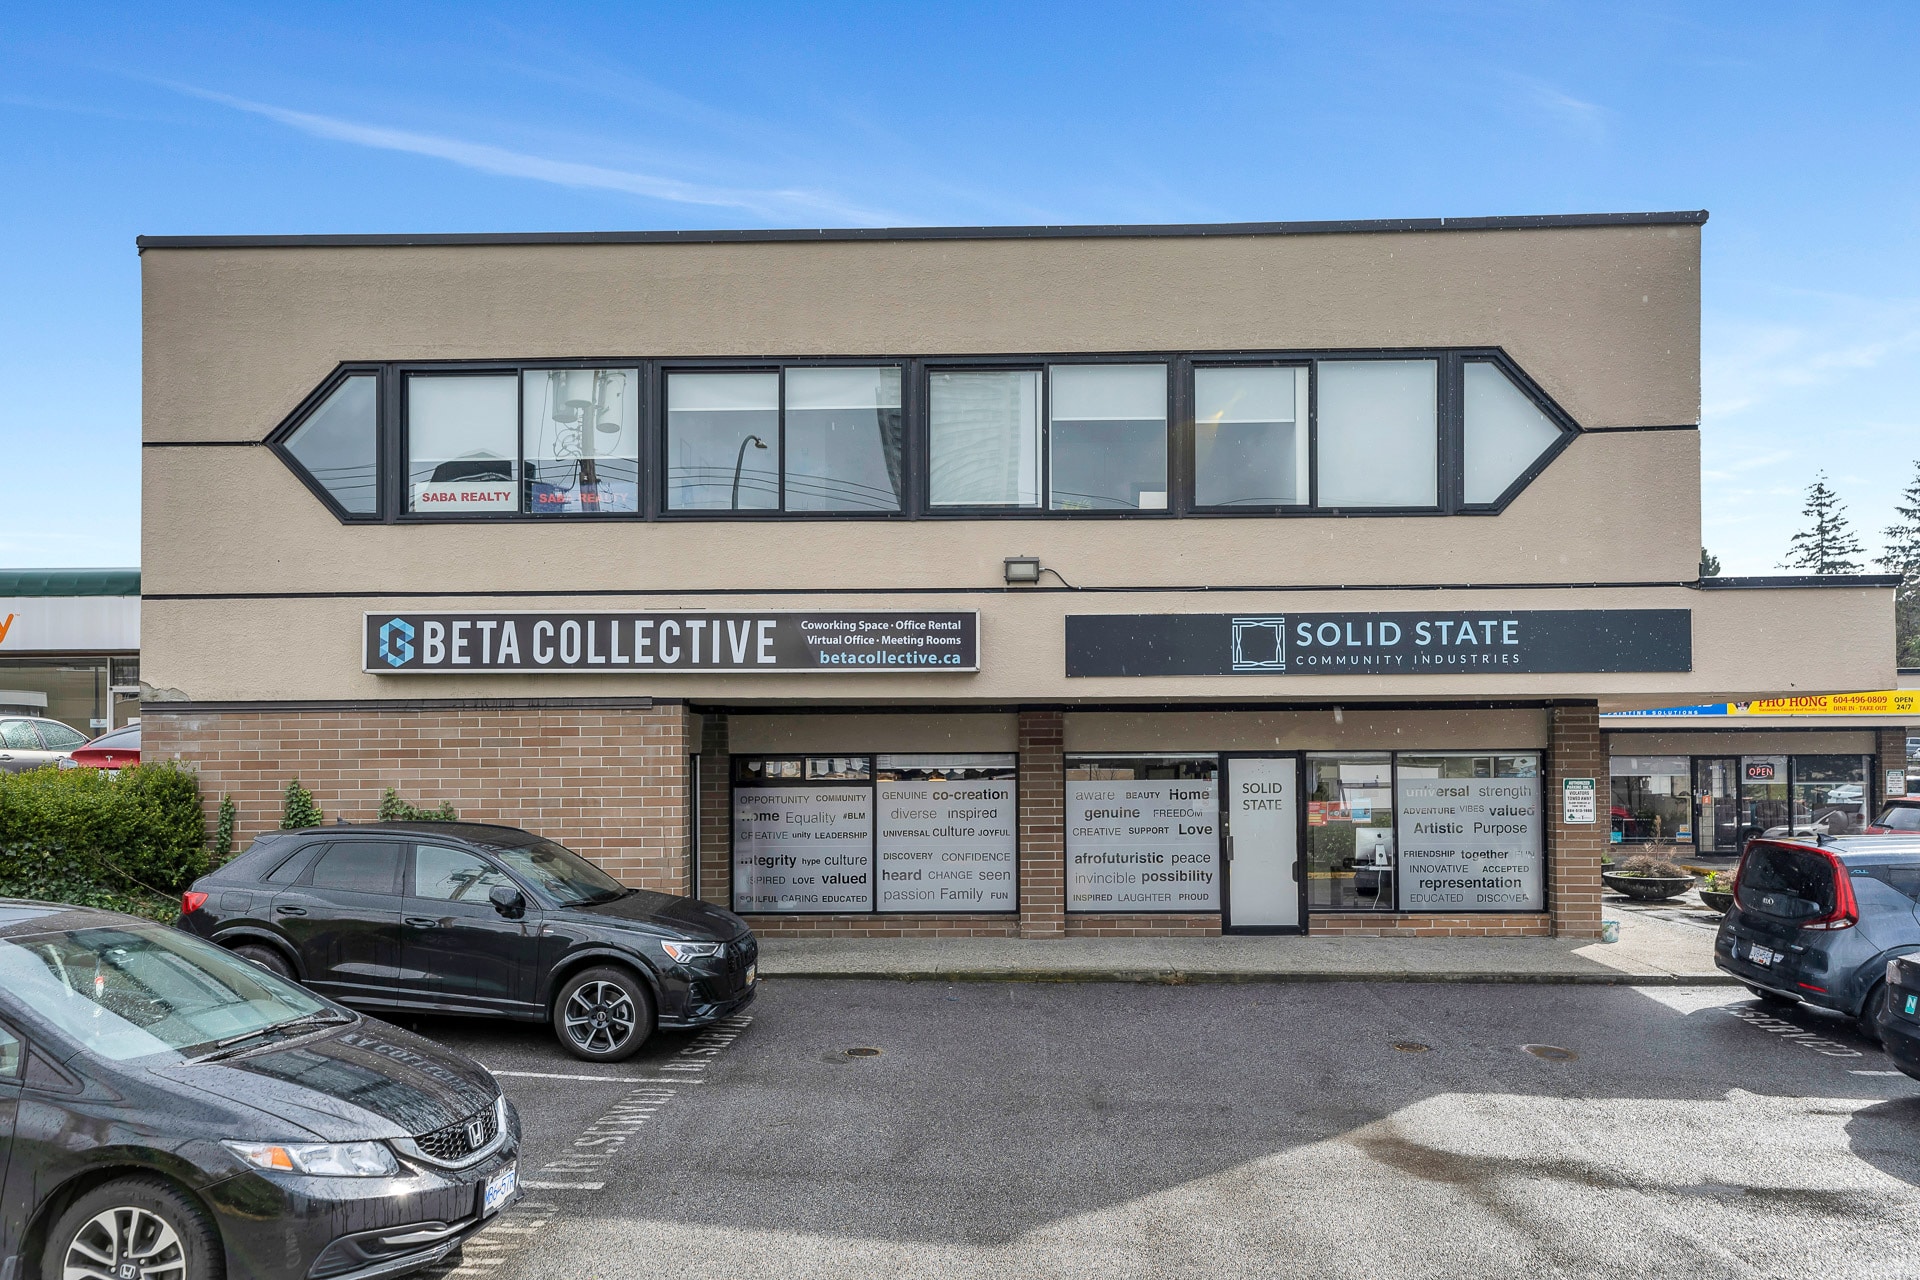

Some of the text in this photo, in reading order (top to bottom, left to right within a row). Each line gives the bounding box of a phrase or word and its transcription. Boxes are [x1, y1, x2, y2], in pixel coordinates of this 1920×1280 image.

[422, 491, 511, 502] SABA REALTY
[800, 620, 961, 632] Coworking Space Office Rental
[1296, 620, 1519, 647] SOLID STATE
[423, 618, 776, 665] BETA COLLECTIVE
[807, 635, 962, 647] Virtual Office Meeting Rooms
[820, 650, 961, 664] betacollective.ca
[1296, 653, 1520, 665] COMMUNITY INDUSTRIES
[1789, 696, 1828, 707] HONG
[1833, 696, 1888, 704] 604-496-0809
[1748, 767, 1773, 776] OPEN
[1242, 782, 1283, 794] SOLID
[1406, 785, 1532, 799] universal strength
[740, 793, 867, 804] OPPORTUNITY COMMUNITY
[882, 788, 1009, 801] GENUINE co-creation
[1075, 789, 1210, 801] aware BEAUTY Home
[1242, 799, 1282, 811] STATE
[1403, 806, 1456, 815] ADVENTURE
[1459, 804, 1485, 813] VIBES
[785, 812, 836, 826] Equality
[843, 812, 866, 820] #BLM
[891, 807, 998, 820] diverse inspired
[1084, 806, 1203, 821] genuine FREEDOM
[883, 826, 1011, 837] UNIVERSAL culture JOYFUL
[1072, 823, 1213, 836] CREATIVE SUPPORT Love
[1413, 822, 1528, 836] Artistic Purpose
[792, 831, 811, 840] unity
[815, 831, 868, 839] LEADERSHIP
[802, 857, 821, 866] hype
[824, 854, 868, 866] culture
[883, 852, 1011, 862] DISCOVERY CONFIDENCE
[1074, 852, 1211, 866] afrofuturistic peace
[1403, 850, 1456, 858] FRIENDSHIP
[1461, 849, 1509, 862] together
[1409, 864, 1530, 873] INNOVATIVE ACCEPTED
[792, 877, 815, 885] LOVE
[822, 872, 867, 885] valued
[882, 869, 1011, 881] heard CHANGE seen
[1075, 870, 1213, 885] invincible possibility
[1419, 876, 1522, 891] representation
[781, 894, 819, 903] CARING
[822, 895, 868, 903] EDUCATED
[883, 888, 935, 903] passion
[940, 888, 984, 902] Family
[1073, 893, 1209, 902] INSPIRED LAUGHTER PROUD
[1410, 894, 1464, 903] EDUCATED
